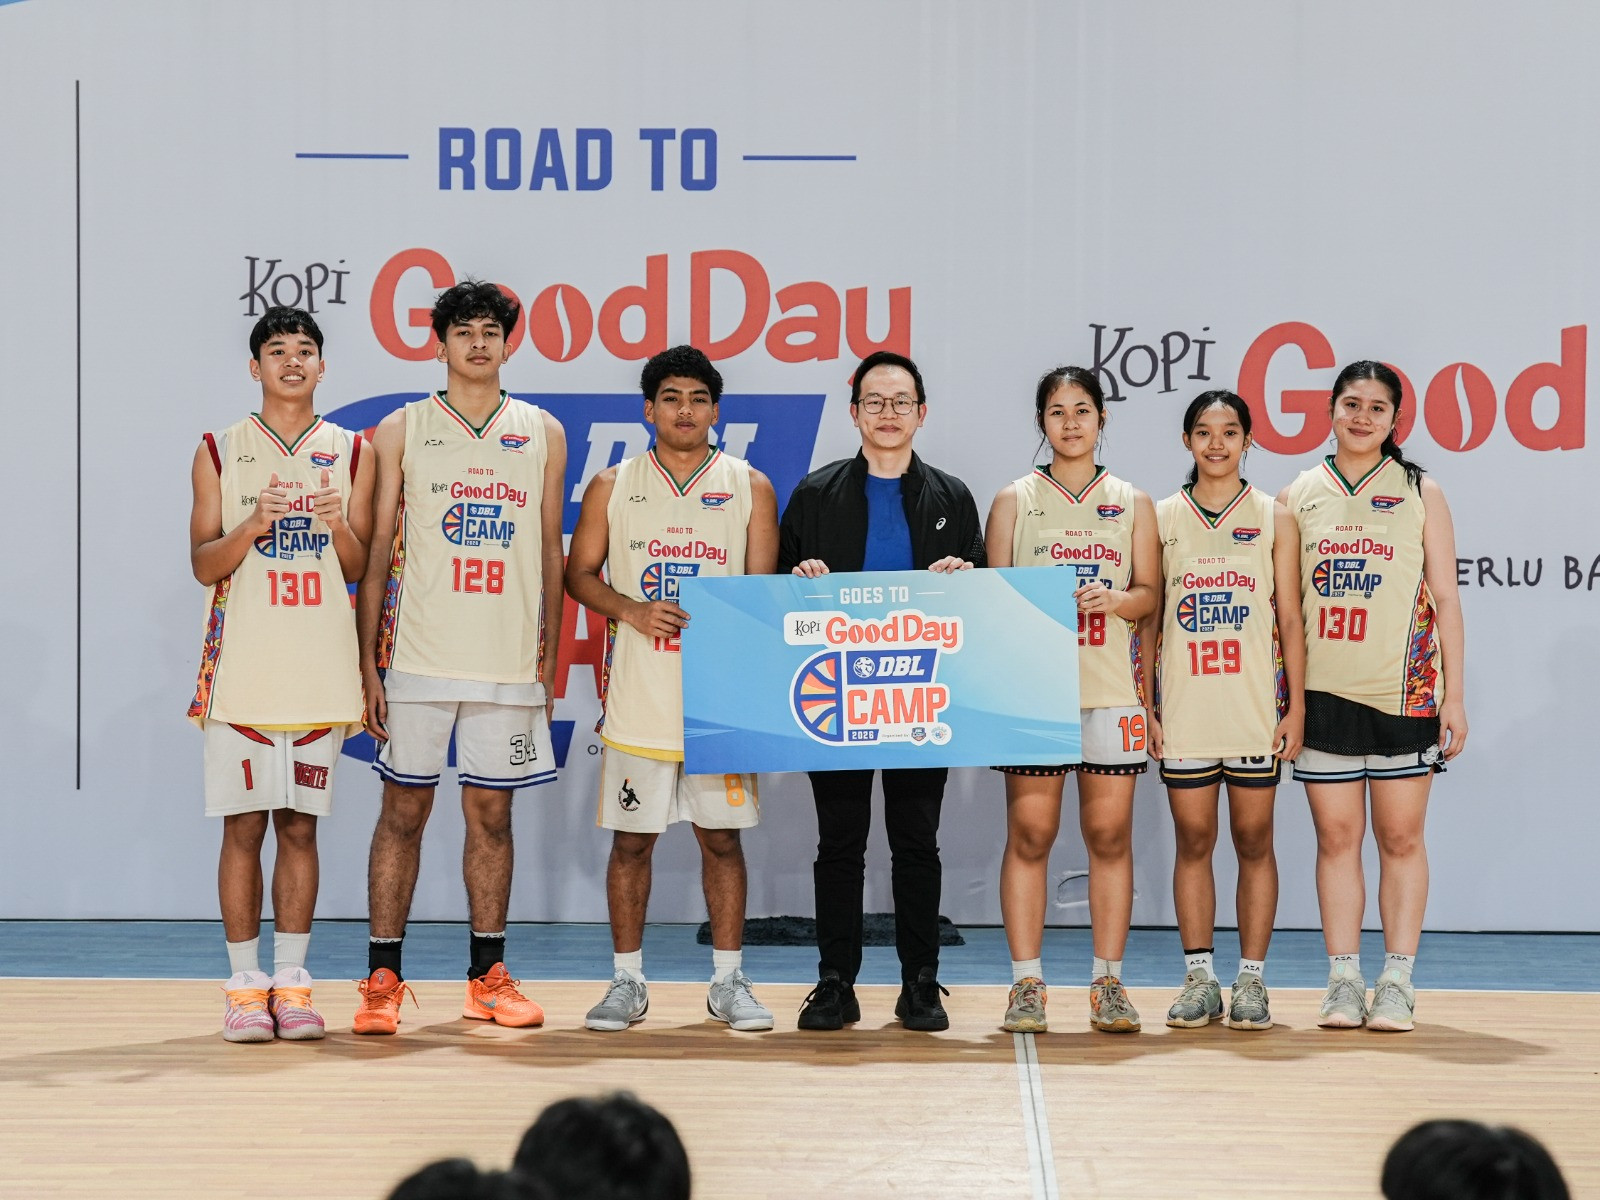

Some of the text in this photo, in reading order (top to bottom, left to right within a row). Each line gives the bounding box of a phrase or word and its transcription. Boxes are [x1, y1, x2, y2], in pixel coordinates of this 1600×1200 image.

[439, 127, 717, 191] ROAD TO
[239, 255, 350, 316] Kopi
[1088, 323, 1216, 402] Kopi
[486, 468, 494, 476] TO
[295, 481, 303, 489] TO
[450, 481, 493, 500] Good
[497, 482, 527, 508] Day
[288, 519, 306, 528] DBL
[477, 508, 496, 516] DBL
[465, 518, 515, 541] CAMP
[279, 531, 329, 552] CAMP
[647, 539, 692, 558] Good
[695, 540, 727, 565] Day
[1318, 538, 1360, 556] Good
[1362, 538, 1394, 561] Day
[1050, 542, 1091, 560] Good
[1094, 543, 1122, 567] Day
[1197, 557, 1215, 565] ROAD
[1344, 561, 1361, 569] DBL
[451, 557, 505, 595] 128
[676, 565, 694, 574] DBL
[1077, 566, 1094, 575] DBL
[266, 570, 323, 607] 130
[1183, 571, 1224, 589] Good
[1226, 570, 1256, 593] Day
[1333, 572, 1382, 592] CAMP
[840, 586, 909, 605] GOES TO
[1210, 594, 1227, 602] DBL
[1199, 605, 1250, 625] CAMP
[1318, 606, 1368, 643] 130
[794, 614, 957, 649] Kopi Good Day
[875, 655, 925, 677] DBL
[1187, 638, 1243, 677] 129
[847, 687, 946, 725] CAMP
[852, 730, 874, 740] 2026
[1118, 714, 1145, 752] 19
[510, 730, 537, 765] 34
[242, 758, 253, 791] 1
[724, 773, 745, 807] 8
